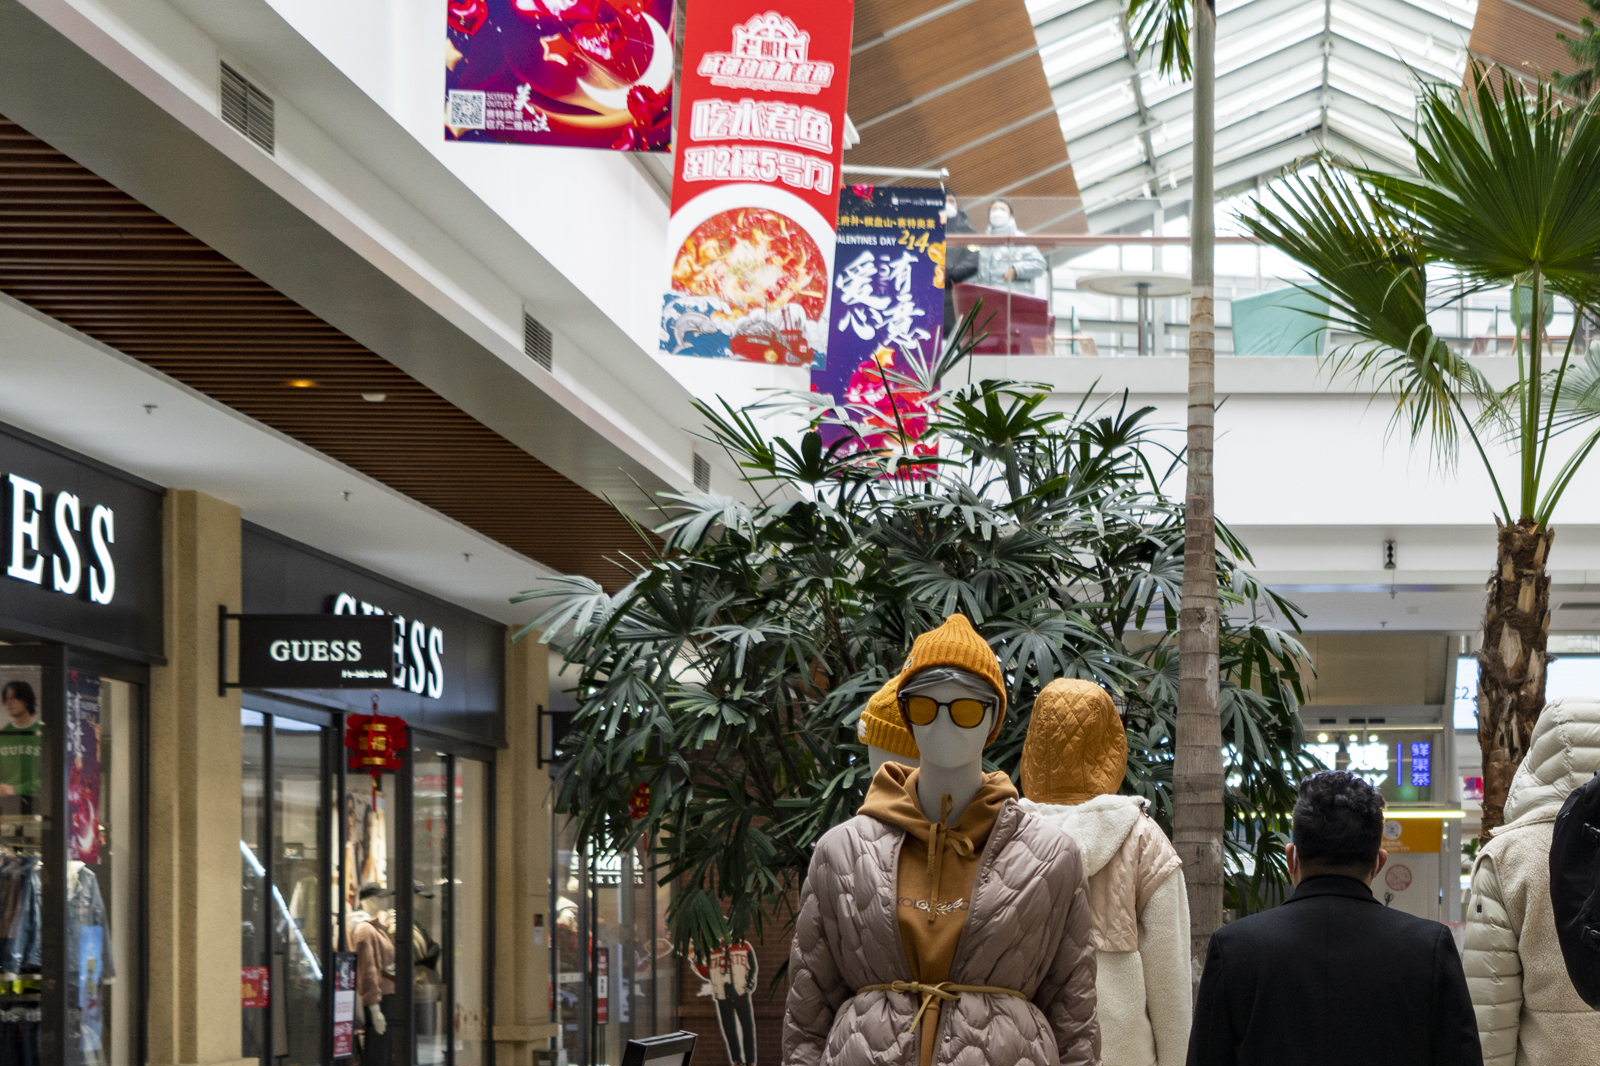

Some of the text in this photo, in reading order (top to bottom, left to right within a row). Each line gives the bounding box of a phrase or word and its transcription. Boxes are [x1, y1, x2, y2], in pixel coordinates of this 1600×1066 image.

[692, 100, 831, 152] 吃水煮鱼
[684, 147, 833, 194] 到2楼5号门
[837, 234, 897, 246] ALENTINES DAY
[898, 230, 930, 253] 214
[270, 639, 362, 662] GUESS
[334, 592, 444, 699] ESS
[1, 745, 41, 756] GUESS
[1410, 742, 1431, 787] 鲜果茶
